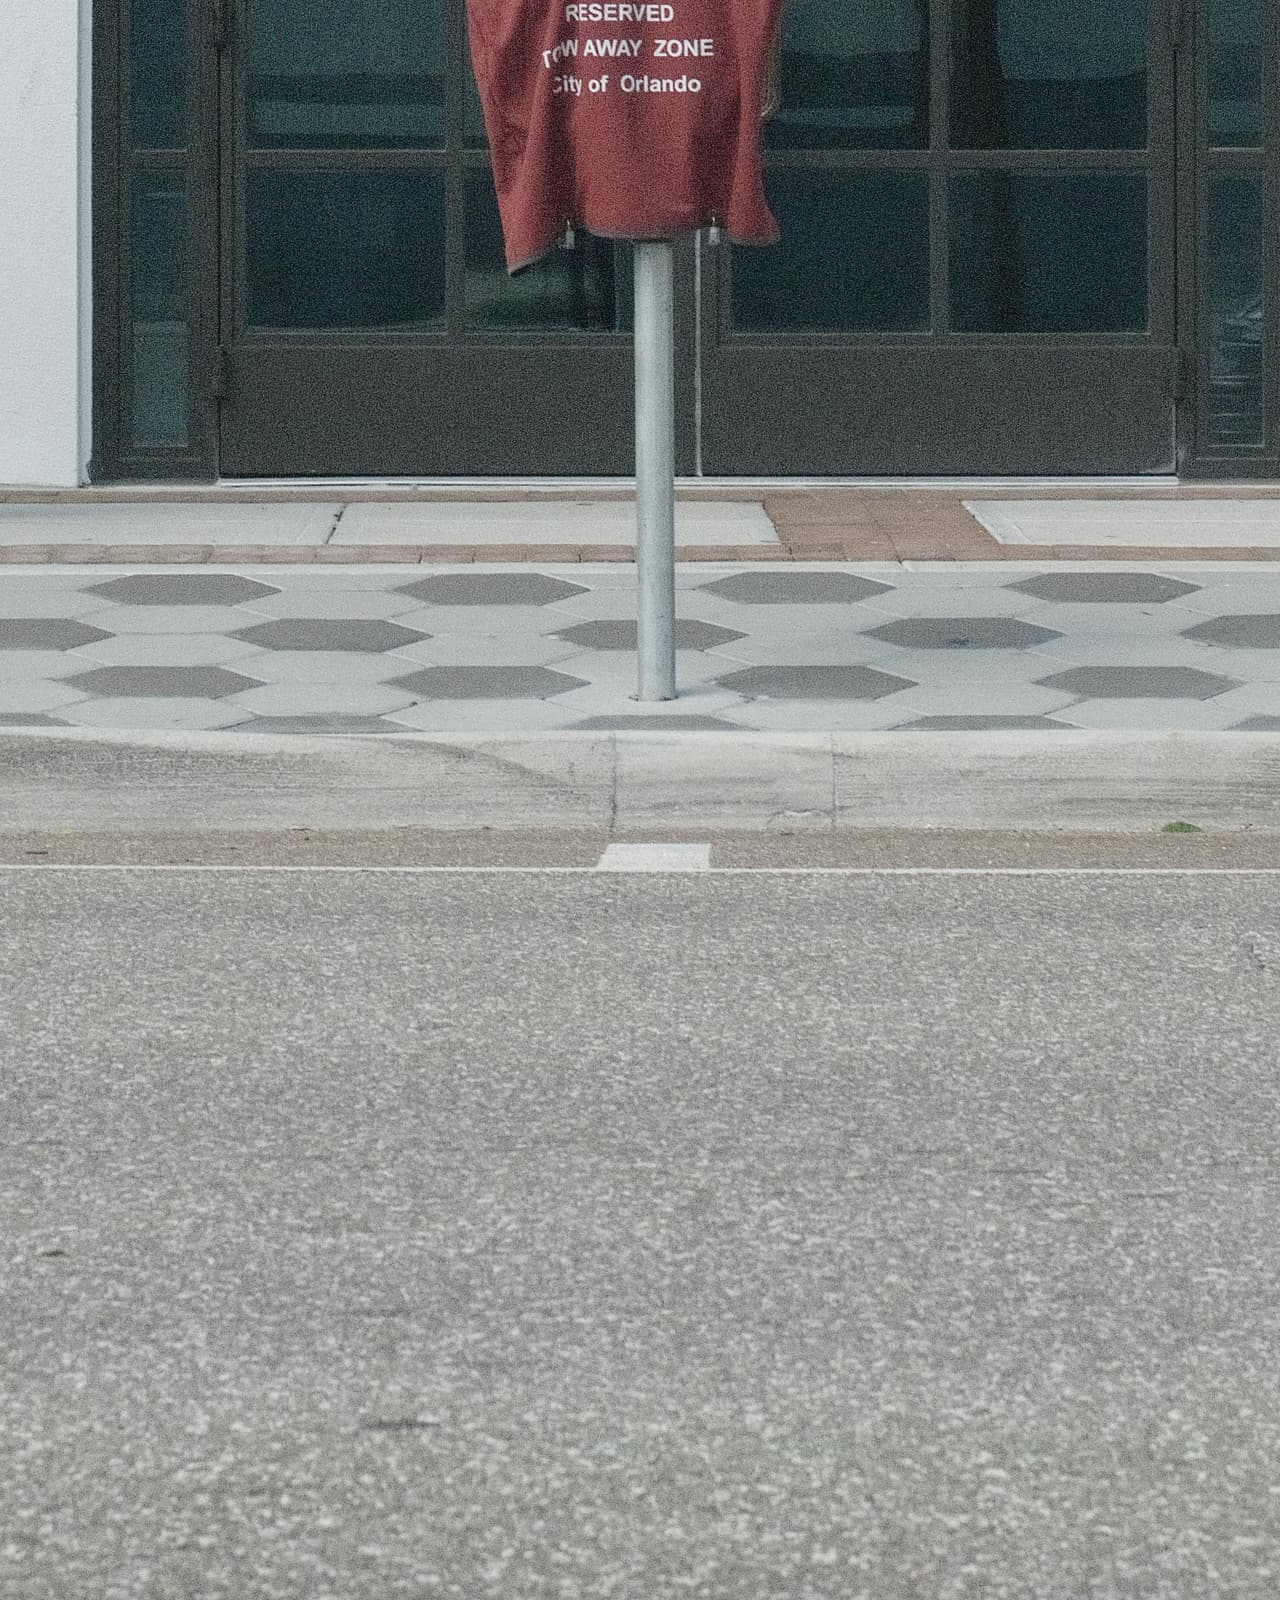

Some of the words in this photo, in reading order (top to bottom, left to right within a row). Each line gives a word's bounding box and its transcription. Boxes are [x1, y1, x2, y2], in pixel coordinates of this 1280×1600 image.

[566, 3, 674, 22] RESERVED
[584, 38, 642, 57] AWAY
[653, 38, 714, 58] ZONE
[588, 74, 609, 93] of
[620, 74, 701, 93] Orlando
